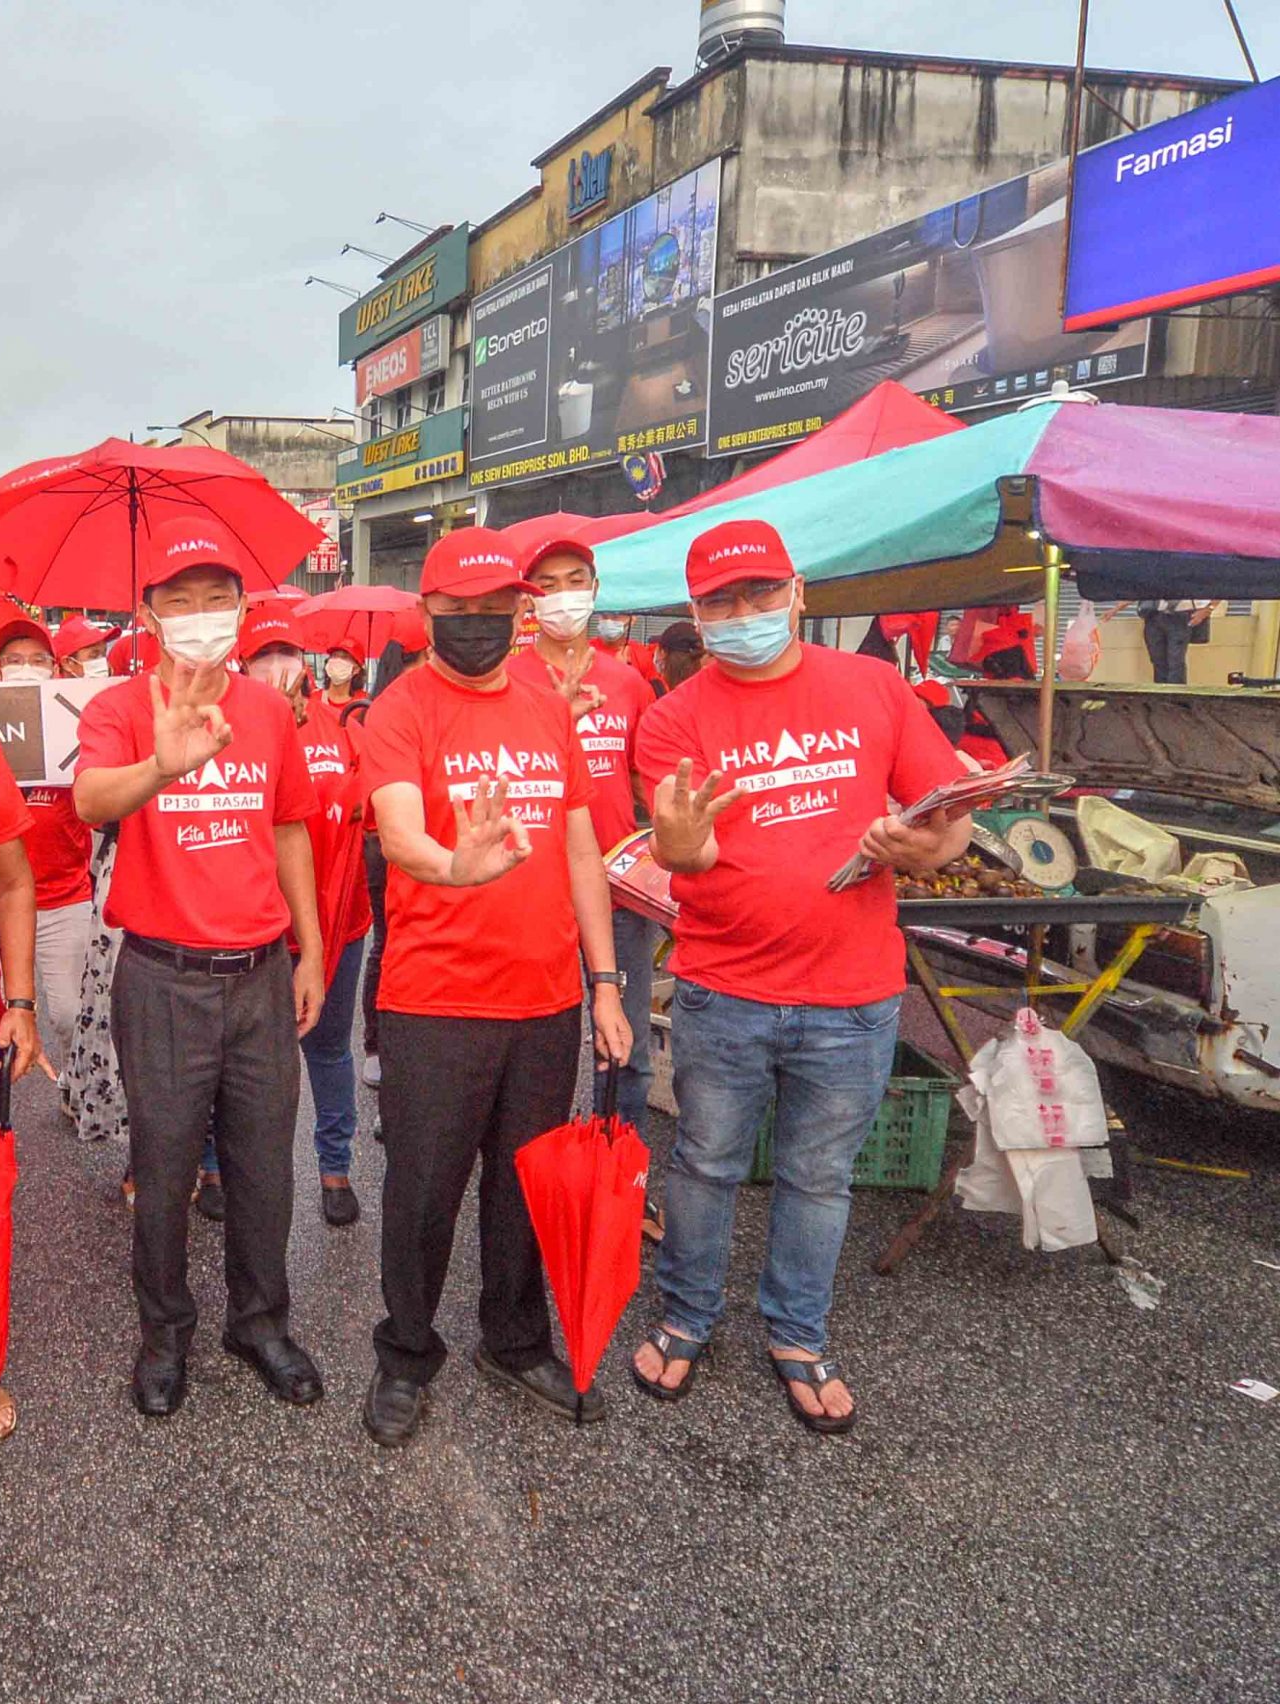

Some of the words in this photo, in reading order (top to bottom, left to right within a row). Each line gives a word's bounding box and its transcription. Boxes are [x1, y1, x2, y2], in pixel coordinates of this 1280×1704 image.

[1116, 117, 1233, 183] Farmasi
[356, 289, 394, 336] WEST
[395, 261, 436, 311] LAKE
[723, 302, 740, 318] KEDAI
[740, 290, 773, 311] PERALATAN
[775, 281, 796, 299] DAPUR
[797, 275, 811, 291] DAN
[812, 268, 830, 285] BILIK
[831, 259, 854, 278] MANDI
[423, 324, 437, 342] TCL
[488, 317, 547, 357] Sorento
[725, 308, 867, 388] sericite
[365, 347, 407, 394] ENEOS
[755, 377, 828, 402] www.inno.com.my
[364, 442, 390, 468] WEST
[392, 431, 419, 456] LAKE
[748, 423, 787, 443] ENTERPRISE
[470, 471, 484, 486] ONE
[485, 468, 501, 482] SIEW
[502, 455, 546, 478] ENTERPRISE
[547, 451, 567, 469] SDN.
[569, 445, 591, 464] BHD.
[167, 539, 219, 556] HARAPAN
[708, 544, 767, 565] HARAPAN
[444, 742, 559, 779] HARAPAN
[720, 727, 861, 772] HARAPAN
[792, 763, 851, 782] RASAH
[164, 798, 199, 809] P130
[213, 796, 259, 808] RASAH
[751, 801, 783, 824] Kita
[177, 824, 205, 845] Kita
